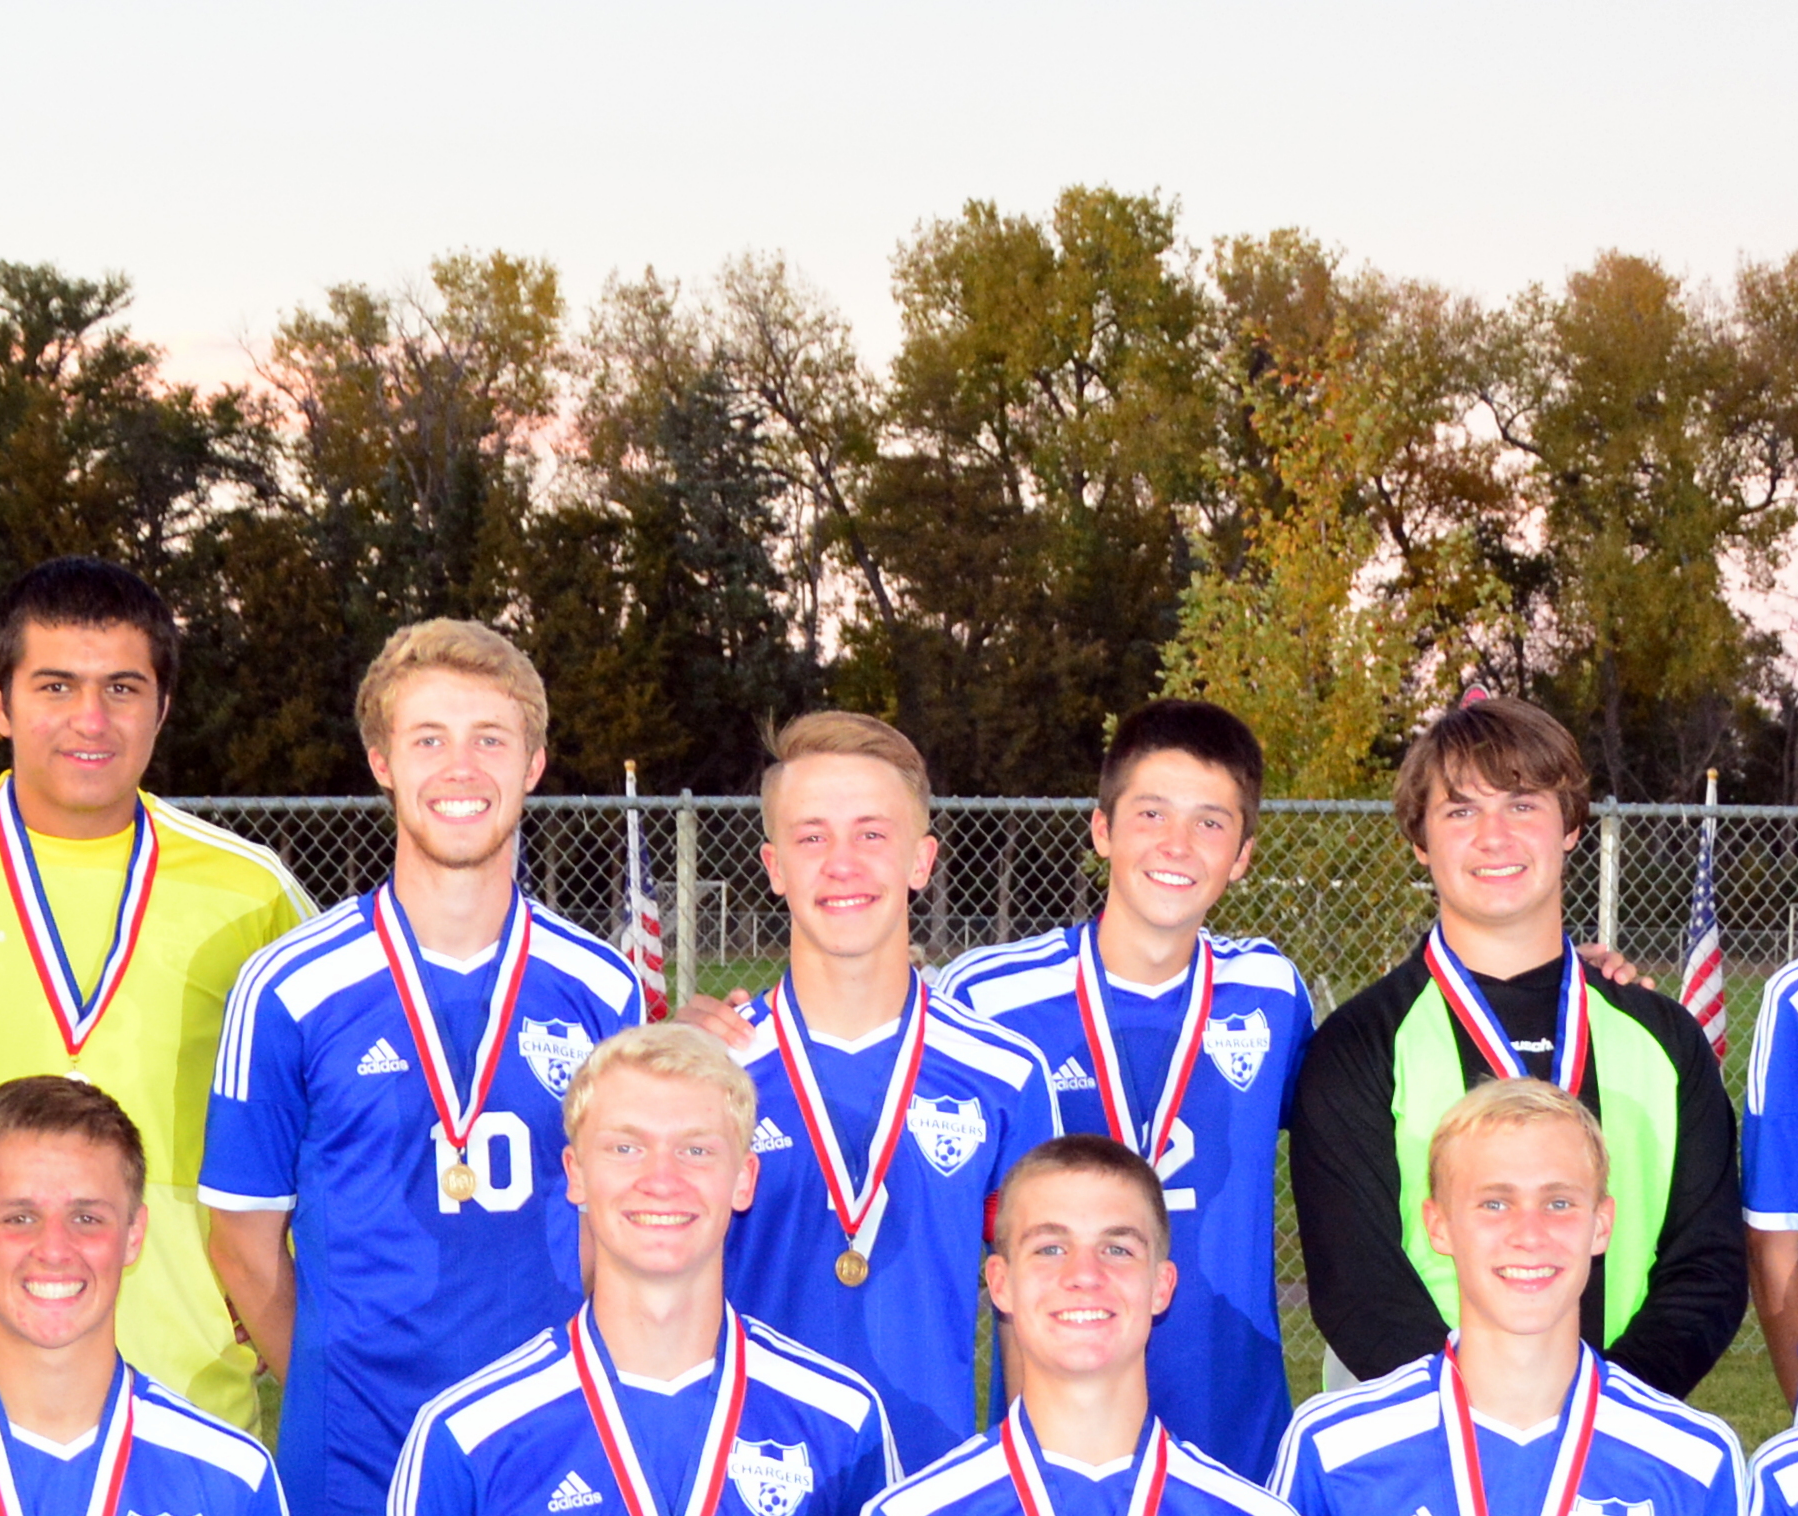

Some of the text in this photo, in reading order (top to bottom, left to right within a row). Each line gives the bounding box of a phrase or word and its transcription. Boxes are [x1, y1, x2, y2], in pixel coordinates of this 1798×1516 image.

[1206, 1035, 1269, 1050] CHARGERS
[357, 1058, 409, 1076] adidas
[909, 1117, 984, 1138] CHARGERS
[430, 1111, 533, 1214] 10
[730, 1462, 811, 1487] CHARGERS
[548, 1490, 602, 1513] adidas
